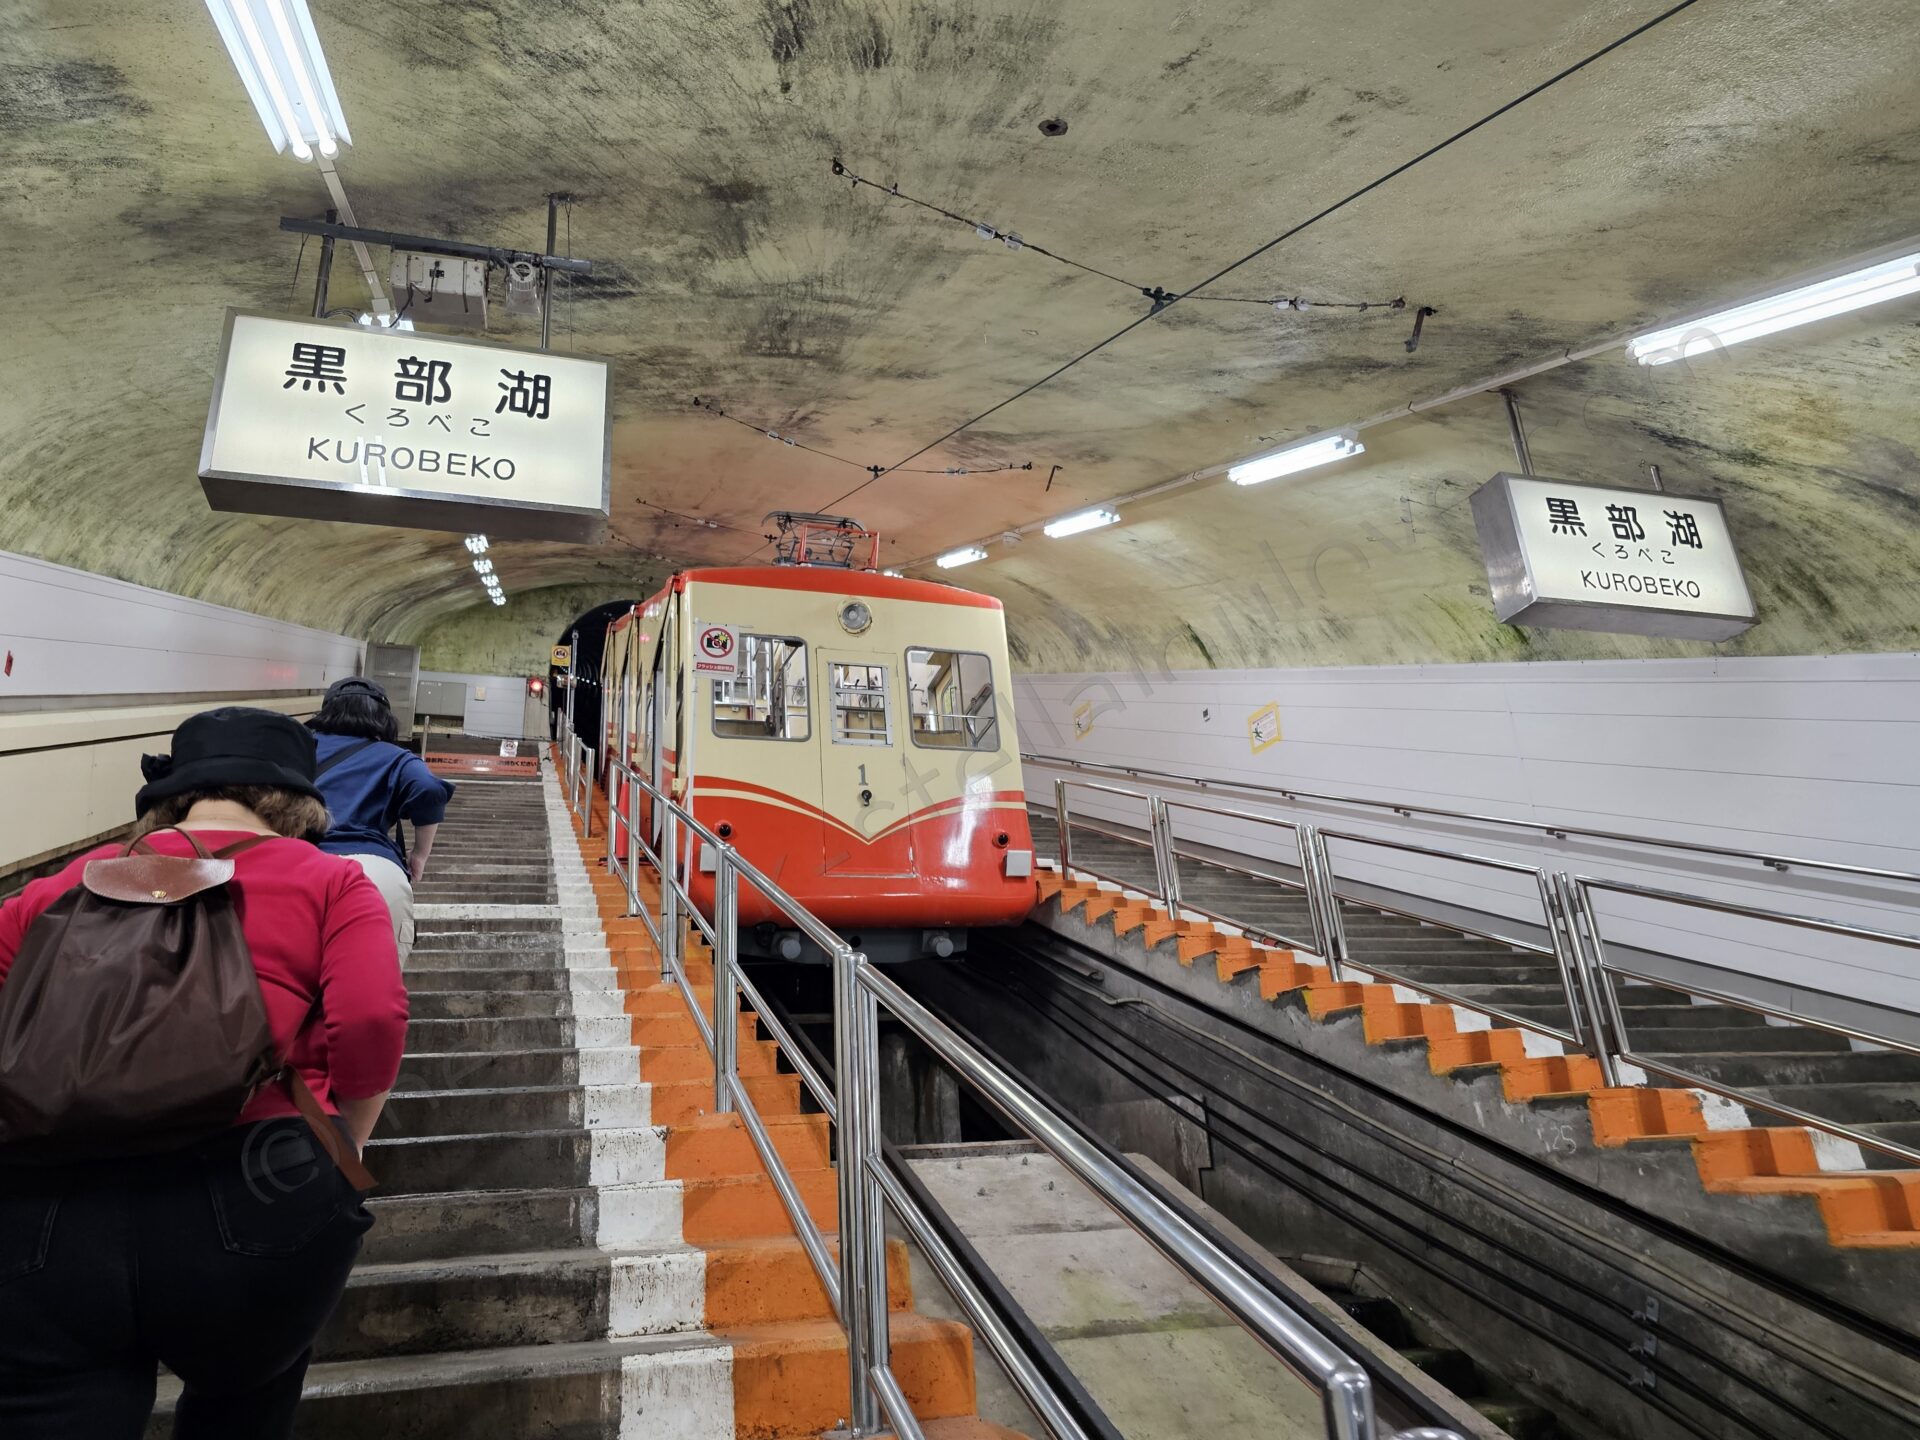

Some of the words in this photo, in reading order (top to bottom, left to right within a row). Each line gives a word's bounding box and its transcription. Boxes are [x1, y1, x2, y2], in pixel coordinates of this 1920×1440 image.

[283, 342, 552, 420] 黒部湖
[345, 403, 491, 437] くろべこ
[308, 437, 516, 481] KUROBEKO
[1545, 497, 1703, 549] 黒部湖
[1592, 542, 1675, 565] くろべこ
[1580, 570, 1701, 598] KUROBEKO
[858, 764, 868, 786] 1
